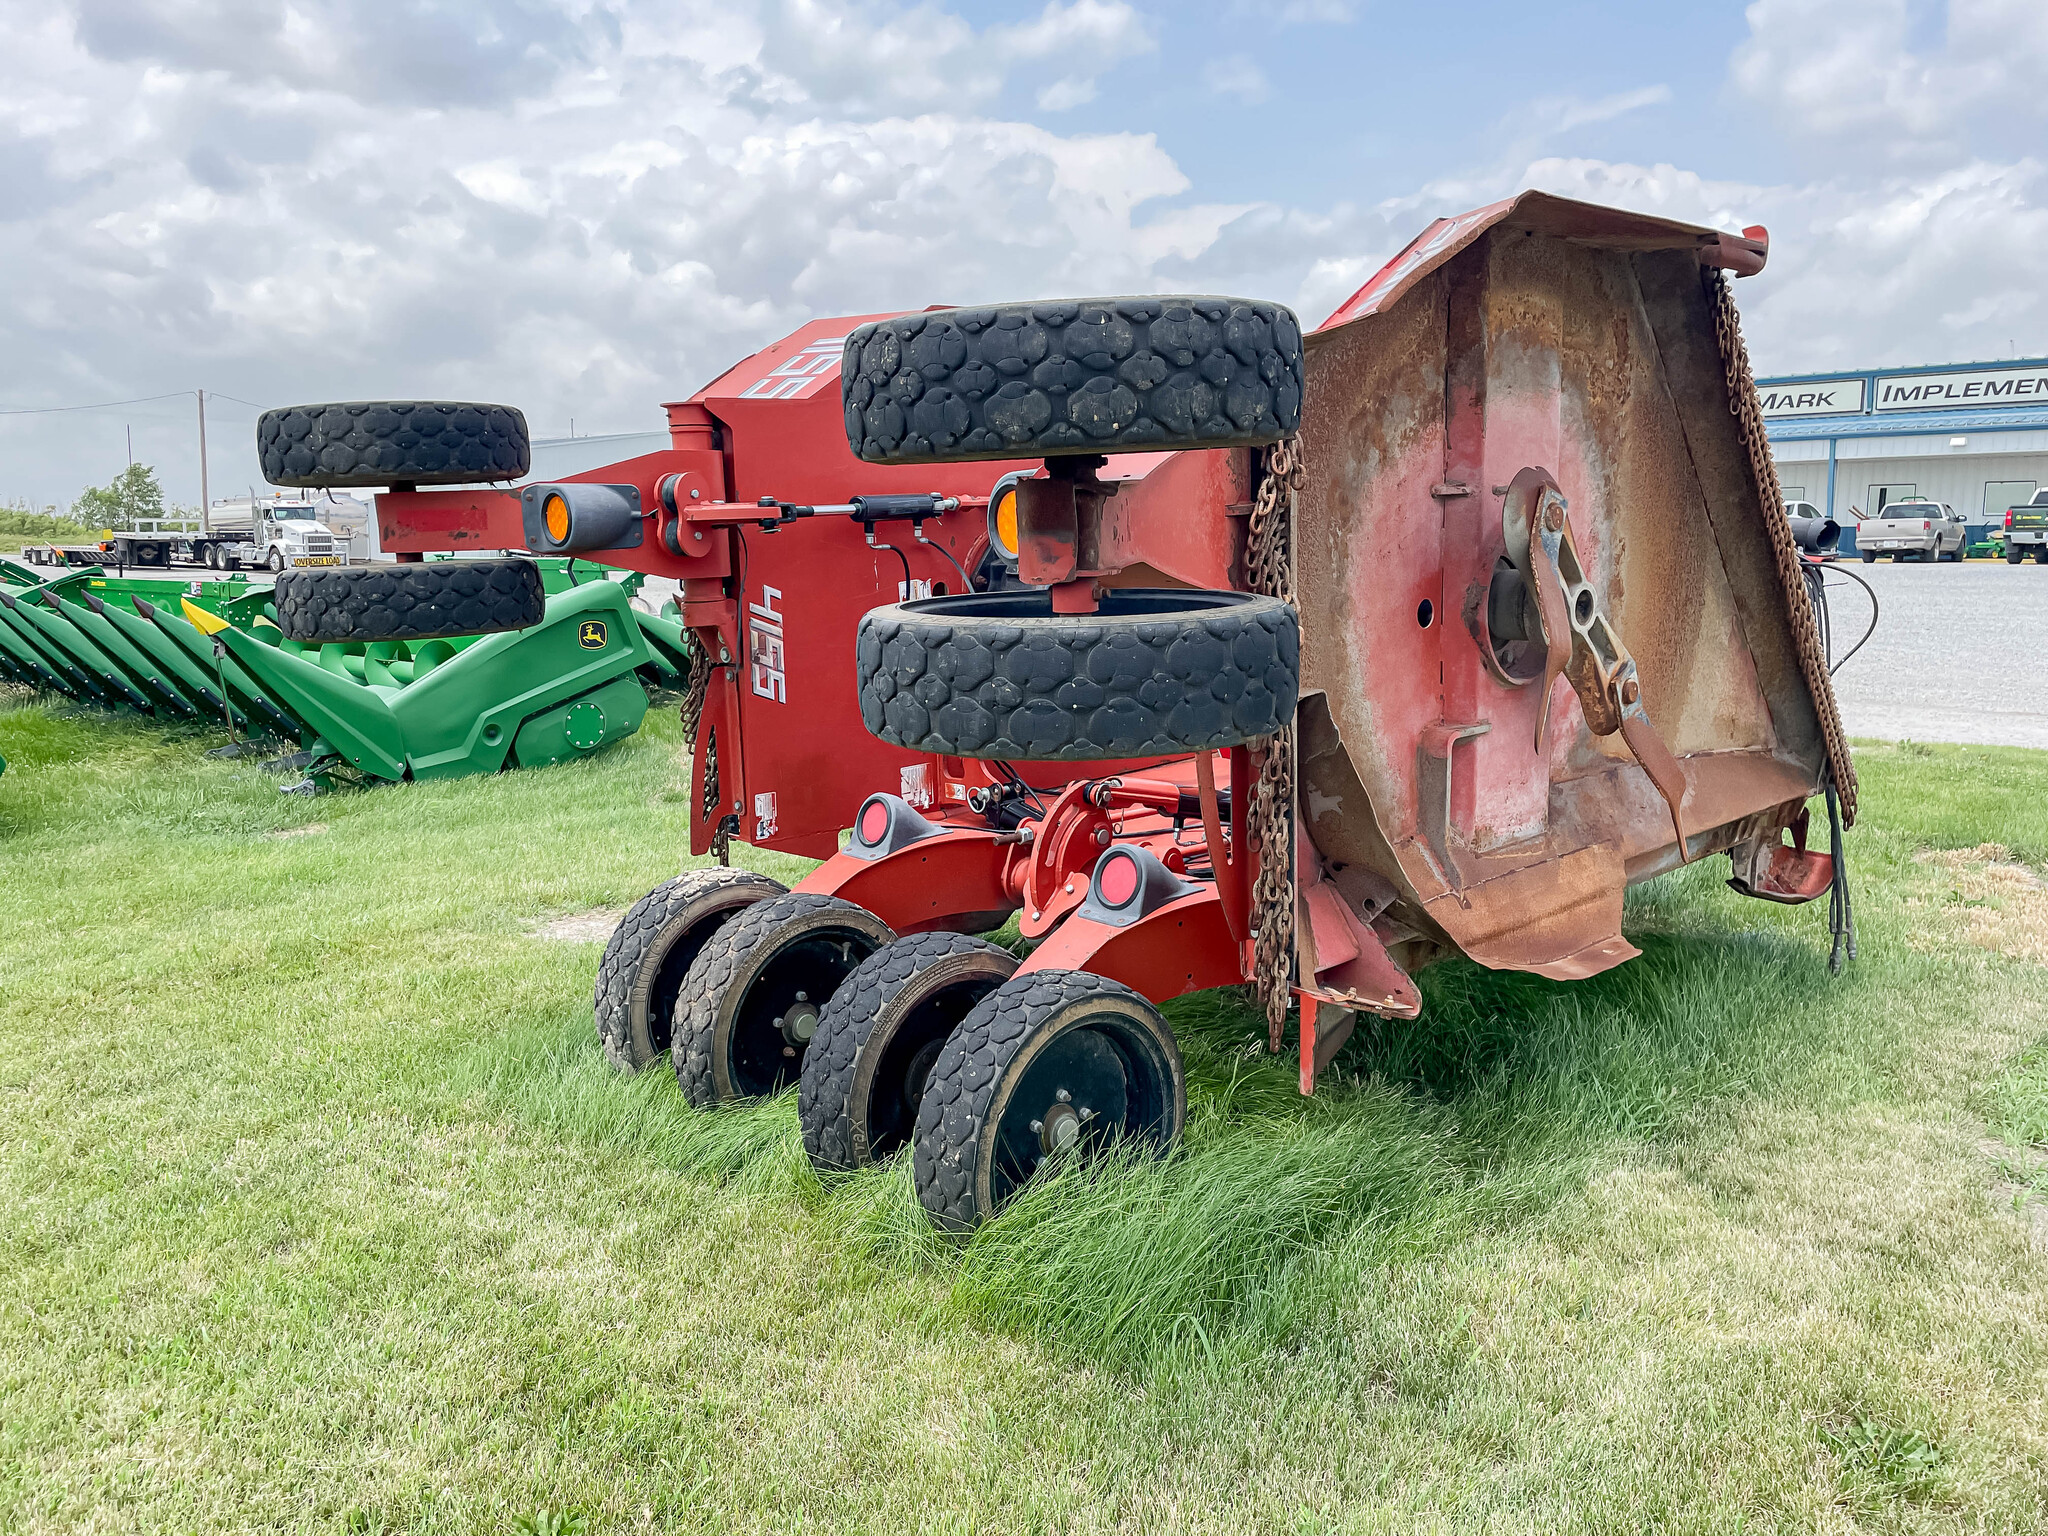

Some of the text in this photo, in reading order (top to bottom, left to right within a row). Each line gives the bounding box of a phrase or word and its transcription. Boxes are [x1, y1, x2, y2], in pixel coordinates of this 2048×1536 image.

[296, 556, 341, 566] OVERSIZE LOAD
[750, 584, 786, 704] 4155
